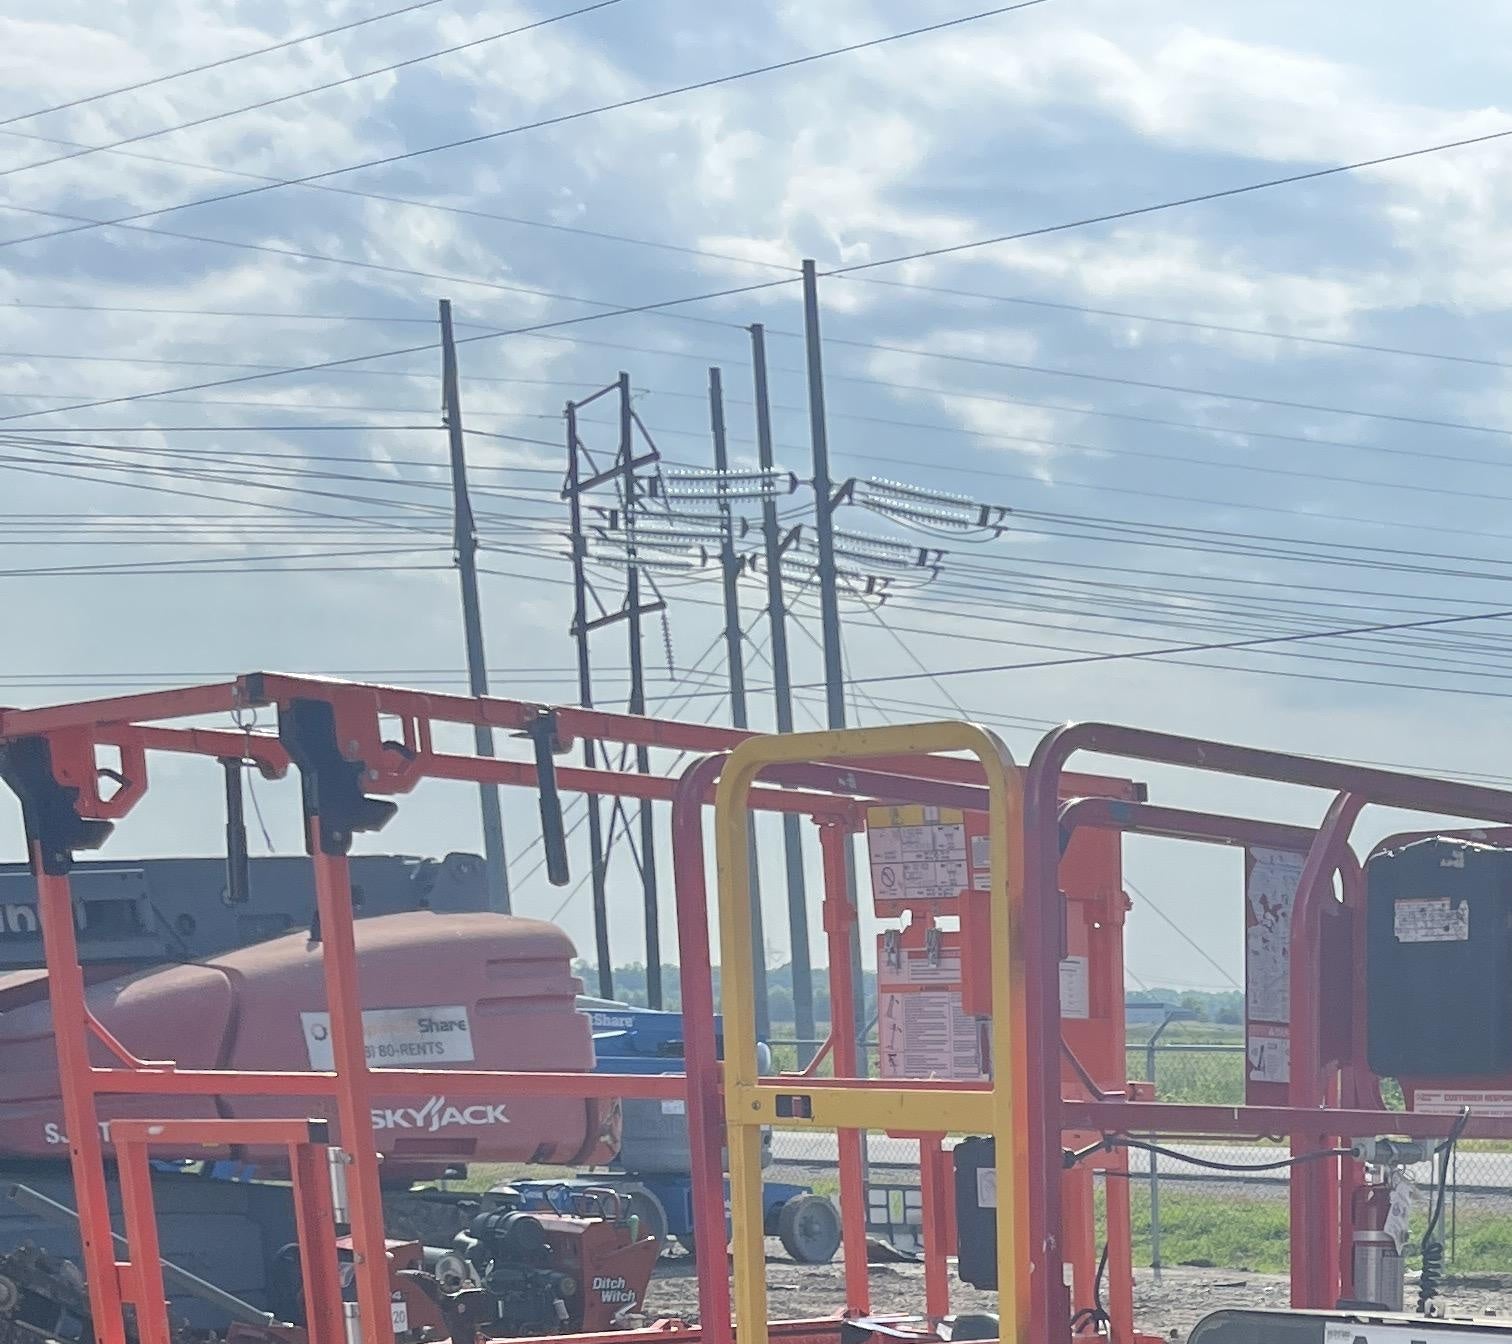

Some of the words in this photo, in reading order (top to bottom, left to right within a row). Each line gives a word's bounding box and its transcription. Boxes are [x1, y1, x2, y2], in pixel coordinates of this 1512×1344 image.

[372, 1096, 511, 1132] SKYJACK
[592, 1276, 626, 1291] Ditch
[601, 1289, 636, 1303] Witch
